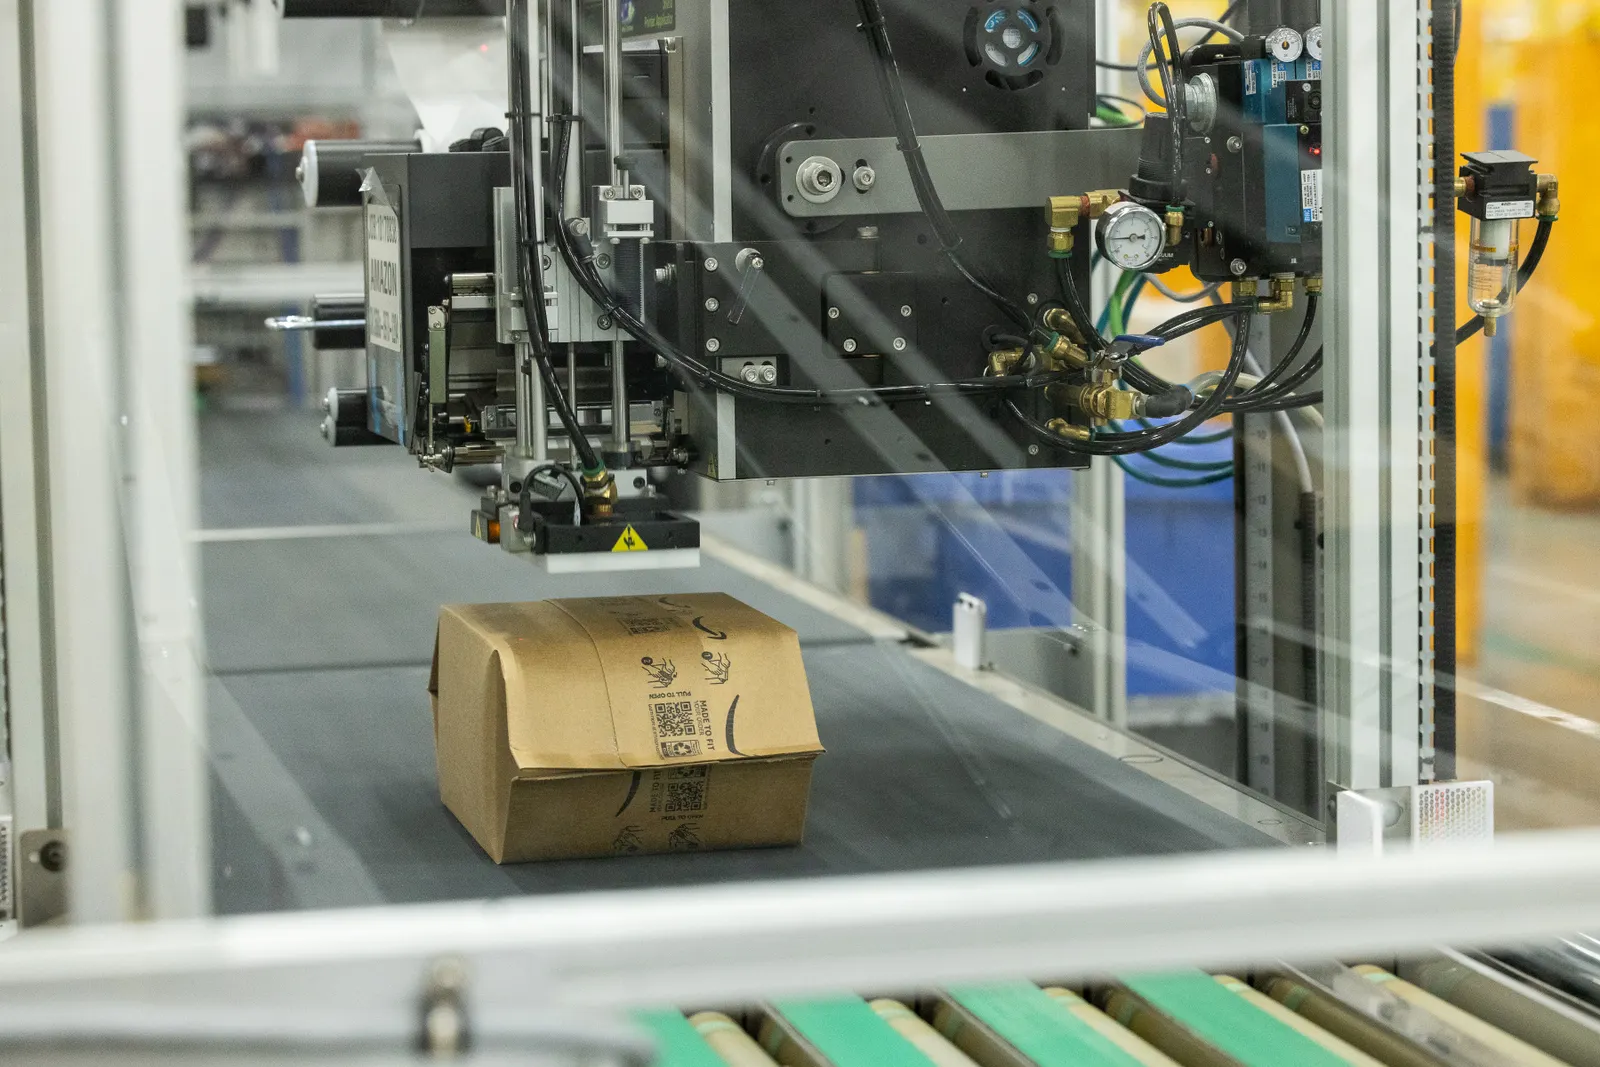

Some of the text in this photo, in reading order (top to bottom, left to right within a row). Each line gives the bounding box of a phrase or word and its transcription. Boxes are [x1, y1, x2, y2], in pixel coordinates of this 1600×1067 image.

[370, 258, 398, 297] AMAZON
[699, 700, 715, 750] MADE TO FIT
